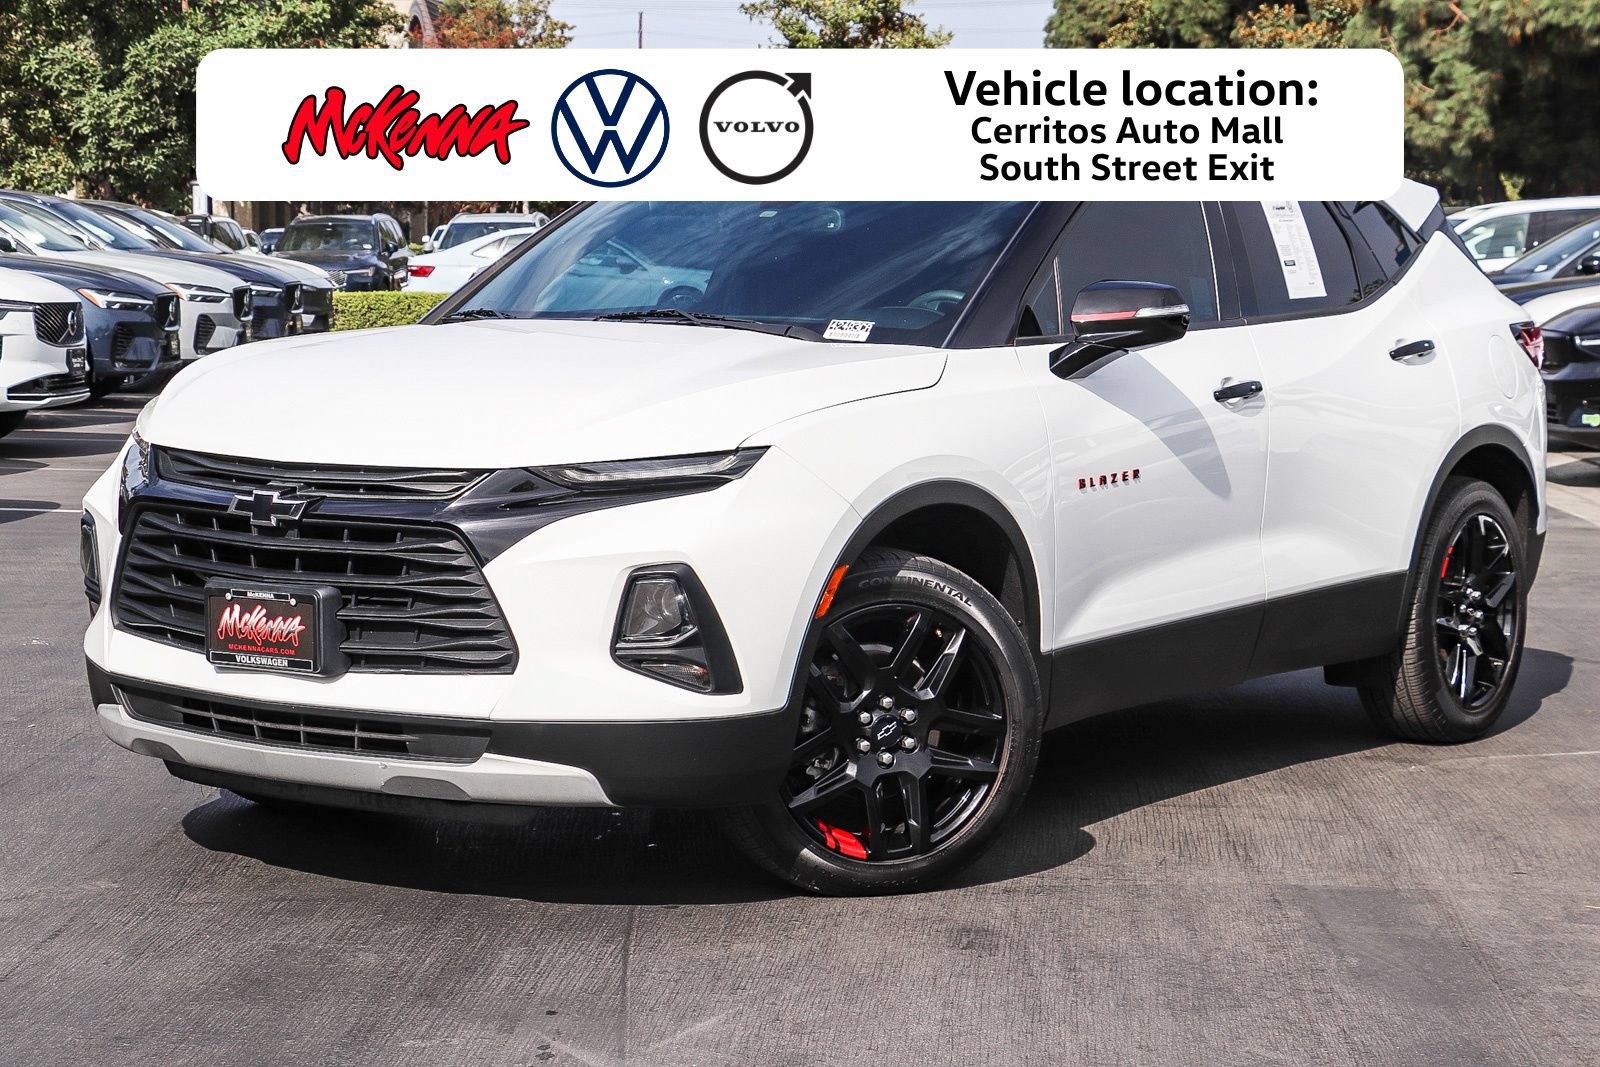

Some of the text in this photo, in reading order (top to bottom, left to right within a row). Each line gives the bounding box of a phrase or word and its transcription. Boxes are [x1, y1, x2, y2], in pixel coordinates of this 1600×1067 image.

[1078, 469, 1140, 490] BLAZER
[858, 575, 973, 607] CONTINENTAL
[228, 643, 296, 656] MCKENNACARS.COM
[235, 655, 289, 667] VOLKSWAGEN
